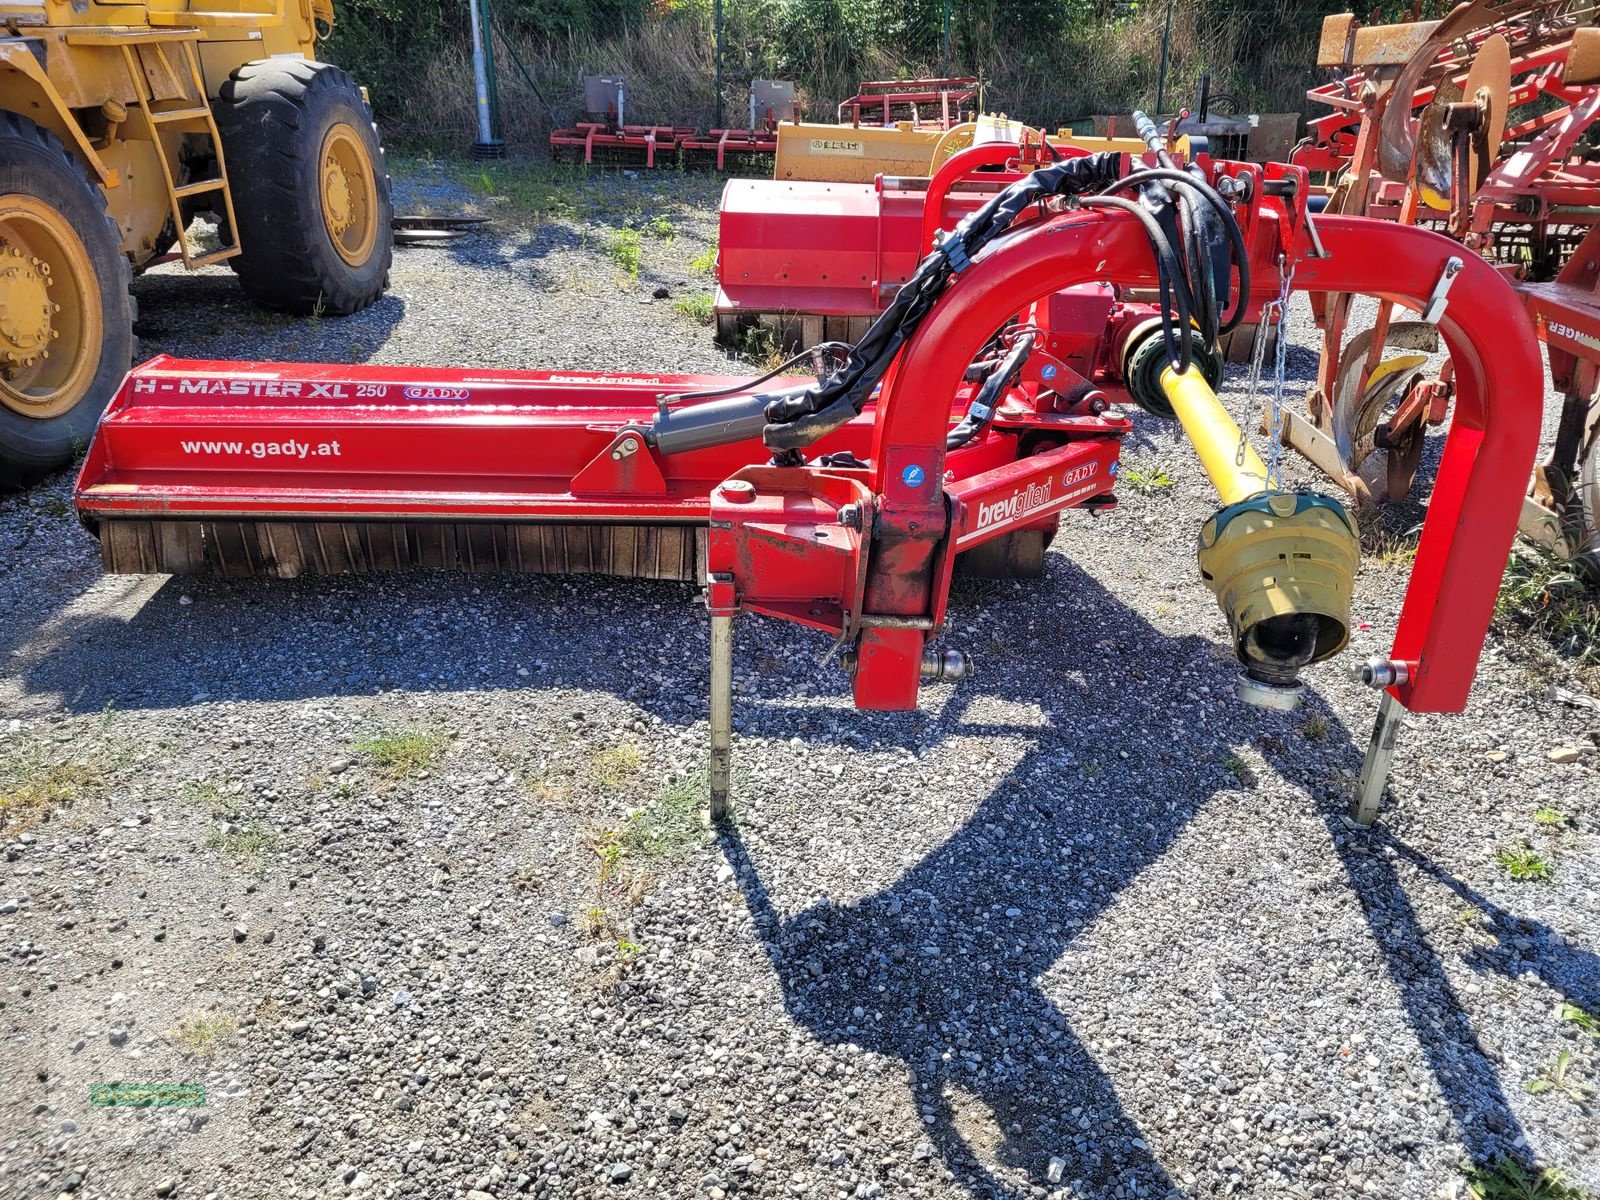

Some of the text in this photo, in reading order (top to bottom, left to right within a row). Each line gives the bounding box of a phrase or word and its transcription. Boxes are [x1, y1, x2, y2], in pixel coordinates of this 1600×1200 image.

[179, 380, 303, 397] MASTER
[310, 383, 349, 398] XL
[356, 384, 387, 398] 250
[409, 386, 465, 399] GADY
[181, 439, 341, 458] www.gady.at
[1065, 464, 1096, 485] GADY
[977, 476, 1053, 529] breviglieri
